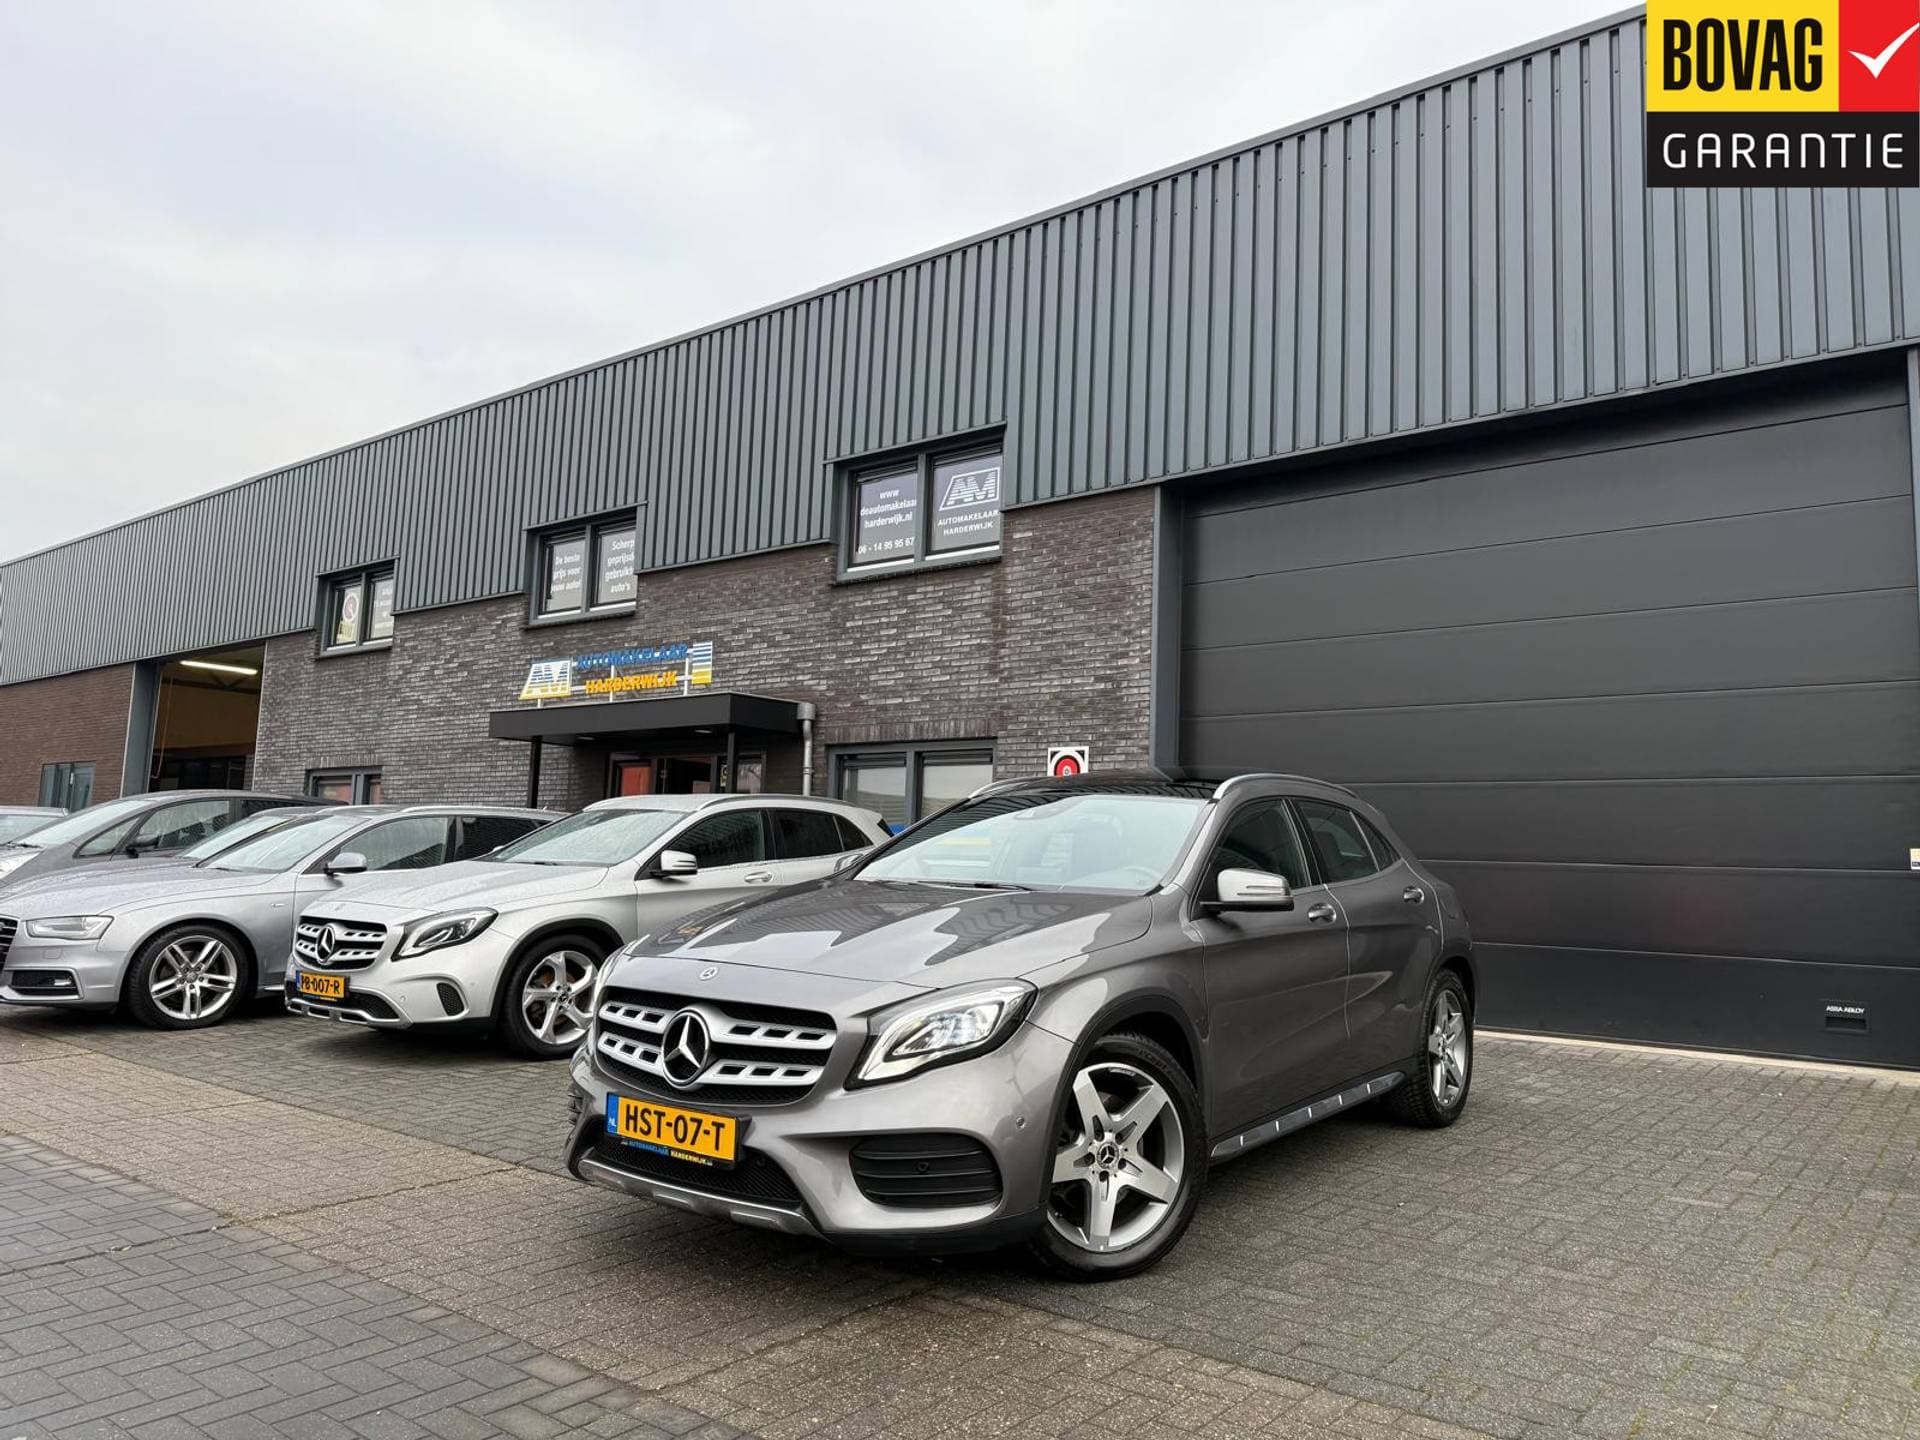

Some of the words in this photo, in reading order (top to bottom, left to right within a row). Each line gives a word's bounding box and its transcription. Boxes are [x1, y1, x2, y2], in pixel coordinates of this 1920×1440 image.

[937, 510, 999, 526] AUTOMAKELAAR
[943, 521, 994, 535] HARDERWIJK
[874, 542, 882, 551] 14
[576, 643, 689, 671] AUTOMAKELAAR
[585, 671, 678, 694] HARDERWIJK
[625, 1103, 726, 1151] HST-07-T
